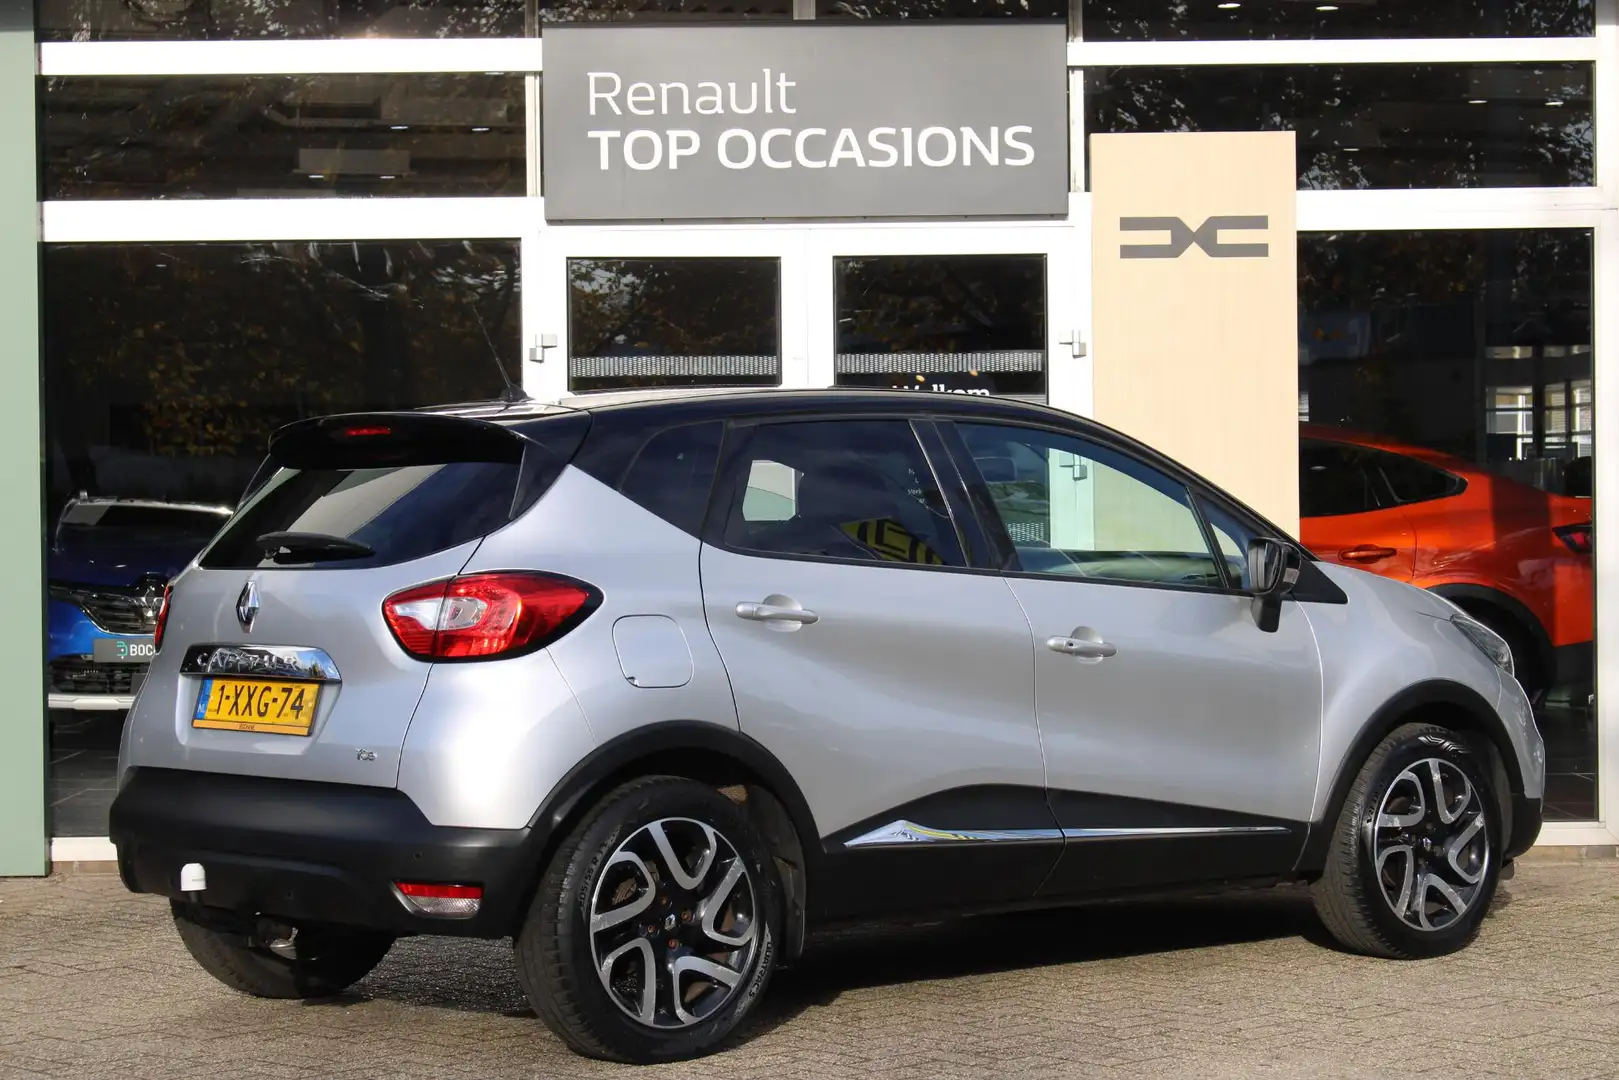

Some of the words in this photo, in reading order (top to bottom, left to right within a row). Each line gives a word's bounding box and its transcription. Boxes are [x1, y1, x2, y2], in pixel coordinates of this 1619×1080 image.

[587, 68, 797, 116] Renault
[587, 129, 701, 171] TOP
[717, 125, 1036, 170] OCCASIONS
[130, 643, 155, 657] BOC
[216, 683, 306, 720] 1-XXG-74
